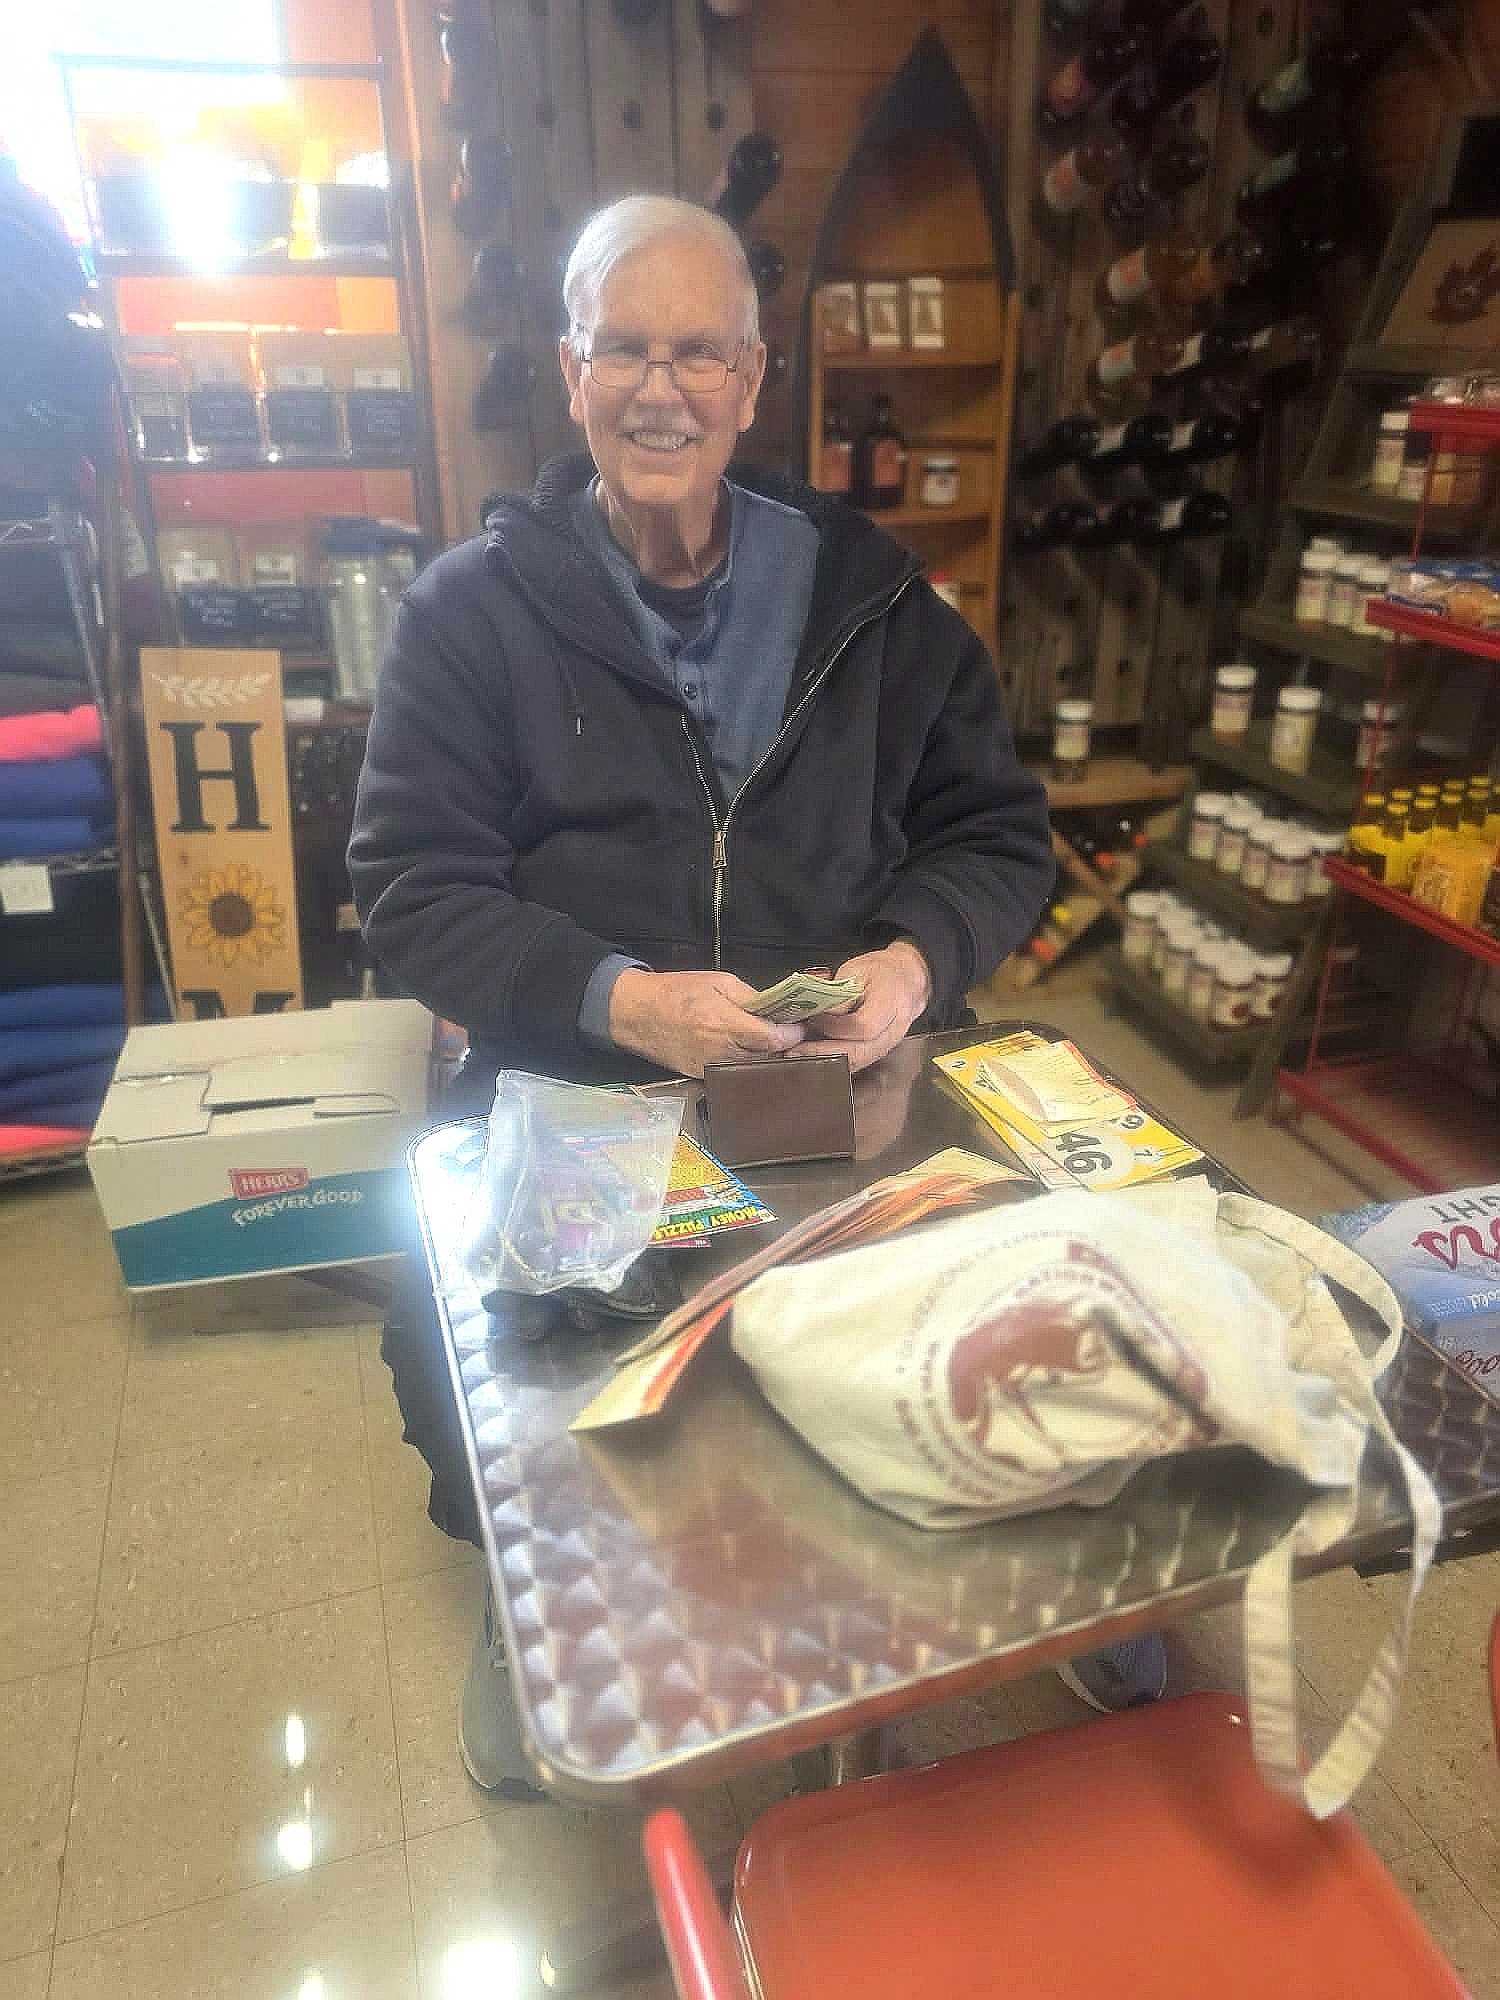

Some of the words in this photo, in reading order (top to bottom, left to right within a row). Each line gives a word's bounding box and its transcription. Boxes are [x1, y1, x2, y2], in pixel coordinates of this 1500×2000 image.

[159, 721, 272, 833] H
[1056, 1132, 1113, 1174] 46
[711, 1205, 758, 1227] MONEY
